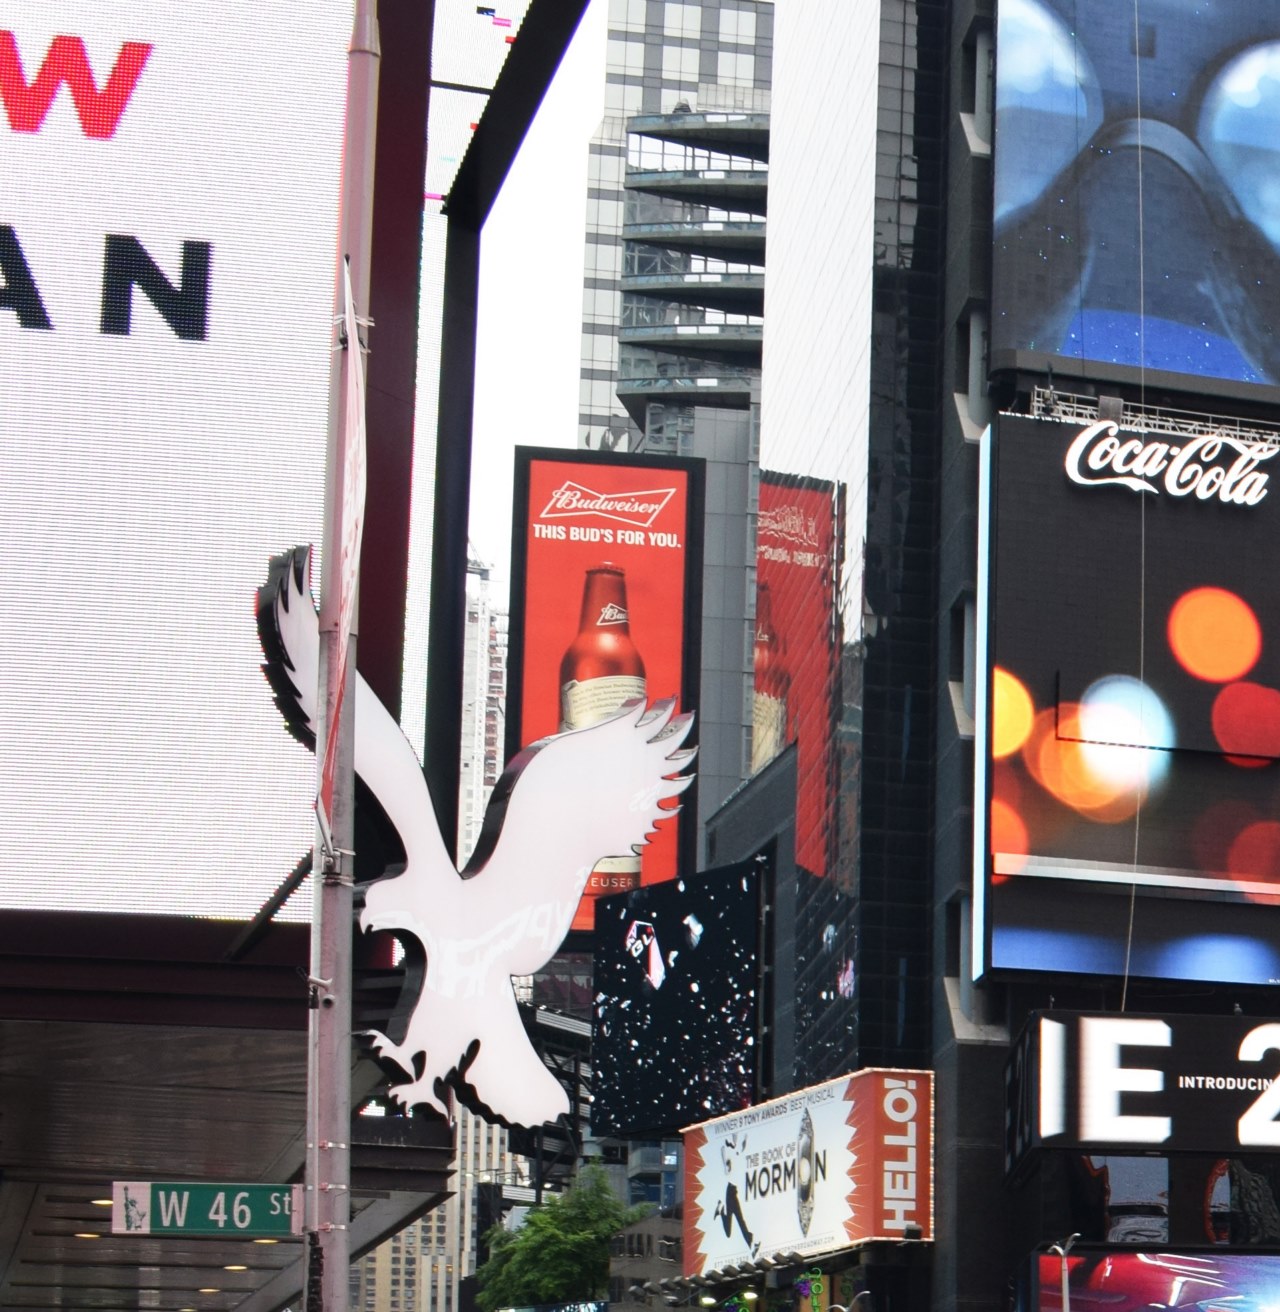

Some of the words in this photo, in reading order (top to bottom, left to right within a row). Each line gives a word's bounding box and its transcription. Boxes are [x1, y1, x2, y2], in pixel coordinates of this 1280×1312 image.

[1066, 421, 1279, 505] Coca-Cola
[552, 488, 660, 516] Budweiser
[533, 524, 567, 541] THIS
[569, 526, 614, 544] BUD'S
[617, 530, 645, 545] FOR
[648, 530, 682, 548] YOU.
[806, 1087, 835, 1108] MUSICAL
[746, 1152, 760, 1169] THE
[762, 1145, 784, 1165] BOOK
[785, 1142, 796, 1159] OF
[884, 1077, 918, 1230] HELLO!
[158, 1191, 190, 1227] W
[208, 1191, 252, 1229] 46
[269, 1192, 292, 1216] St
